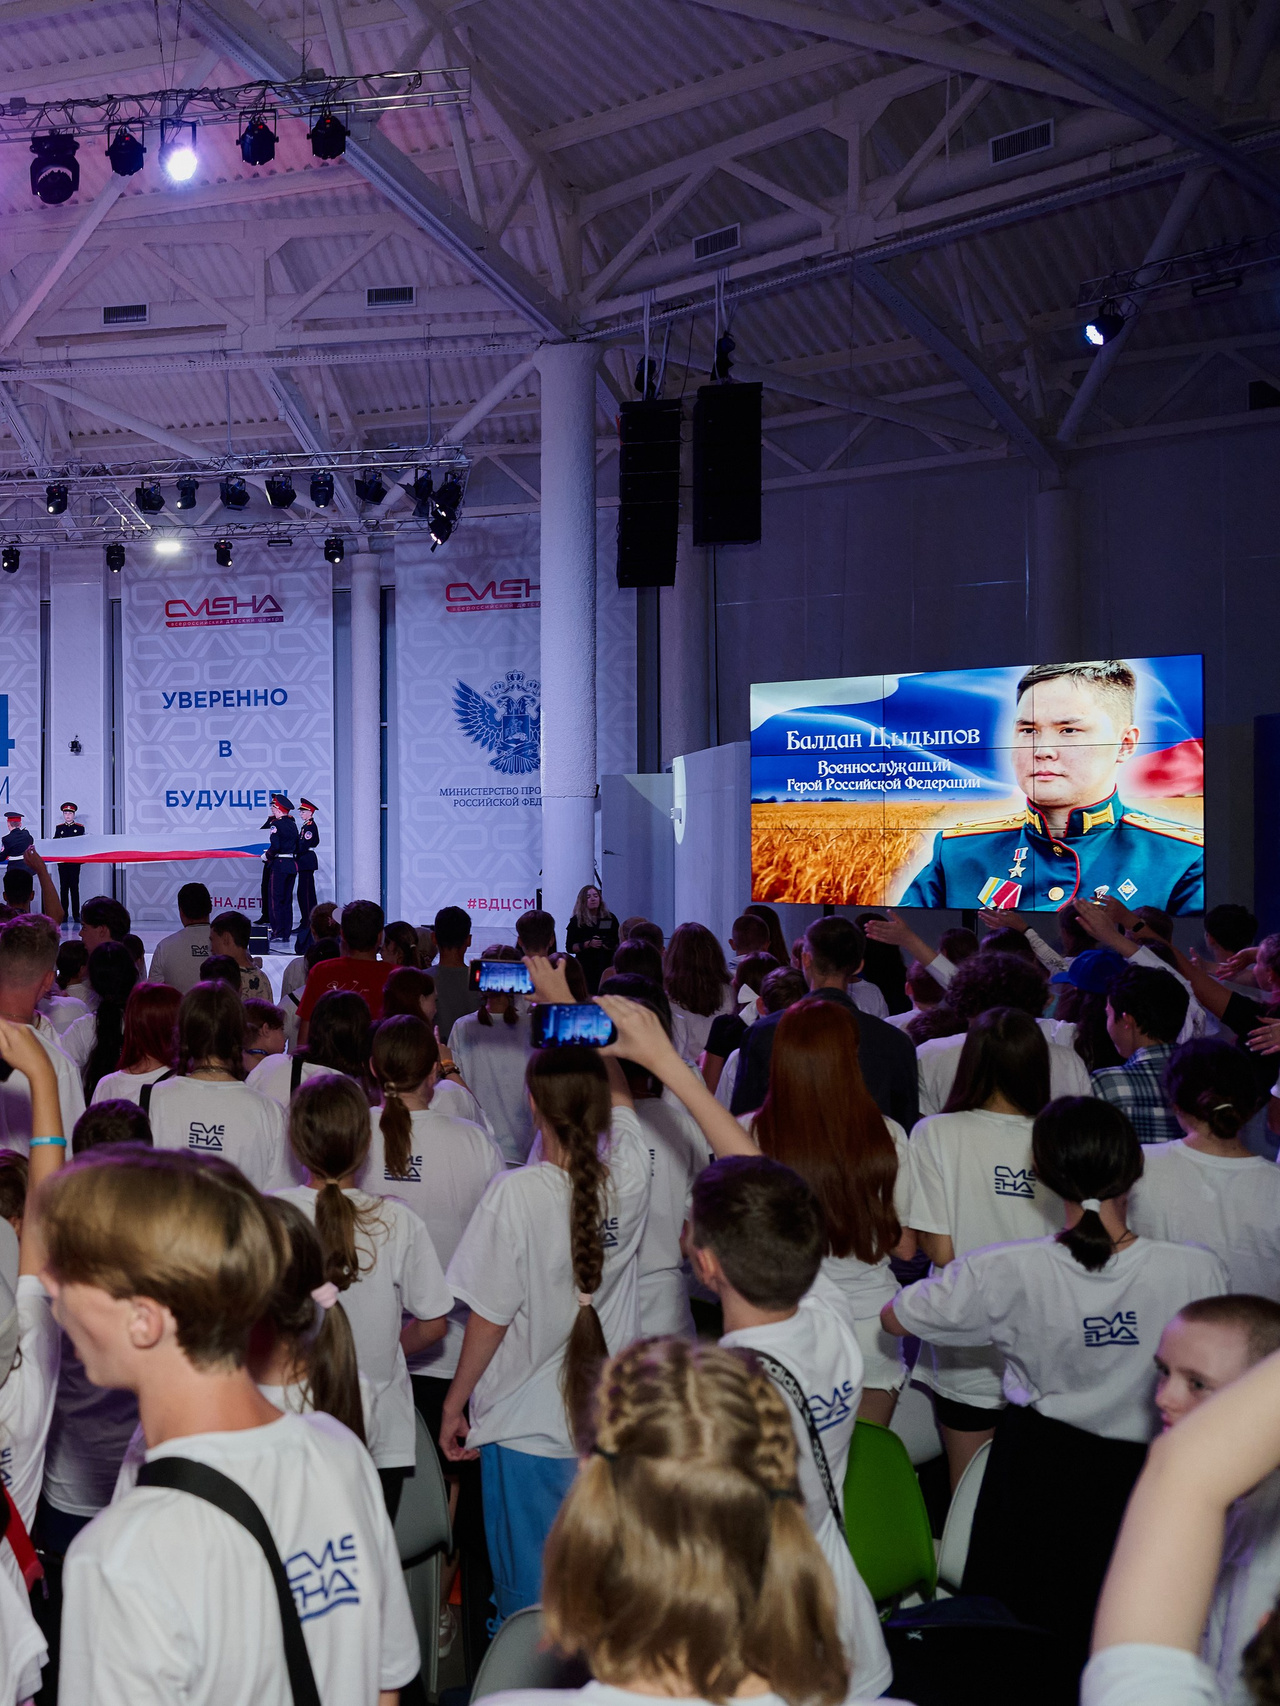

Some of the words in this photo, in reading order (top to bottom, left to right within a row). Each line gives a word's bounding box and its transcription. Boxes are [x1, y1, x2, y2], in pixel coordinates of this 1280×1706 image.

[446, 578, 540, 602] СМЕН
[162, 687, 288, 710] УВЕРЕННО
[786, 730, 862, 751] Балдан
[869, 726, 980, 749] Цыдыпов
[219, 740, 233, 758] В
[817, 759, 952, 778] Военнослужащий
[439, 787, 519, 797] МИНИСТЕРСТВО
[520, 786, 541, 795] ПРО
[787, 778, 823, 794] Герой
[825, 777, 902, 793] Российской
[904, 776, 981, 792] Федерации
[453, 797, 519, 808] РОССИЙСКОЙ
[521, 797, 542, 807] ФЕД
[467, 898, 535, 911] #ВДЦСМ
